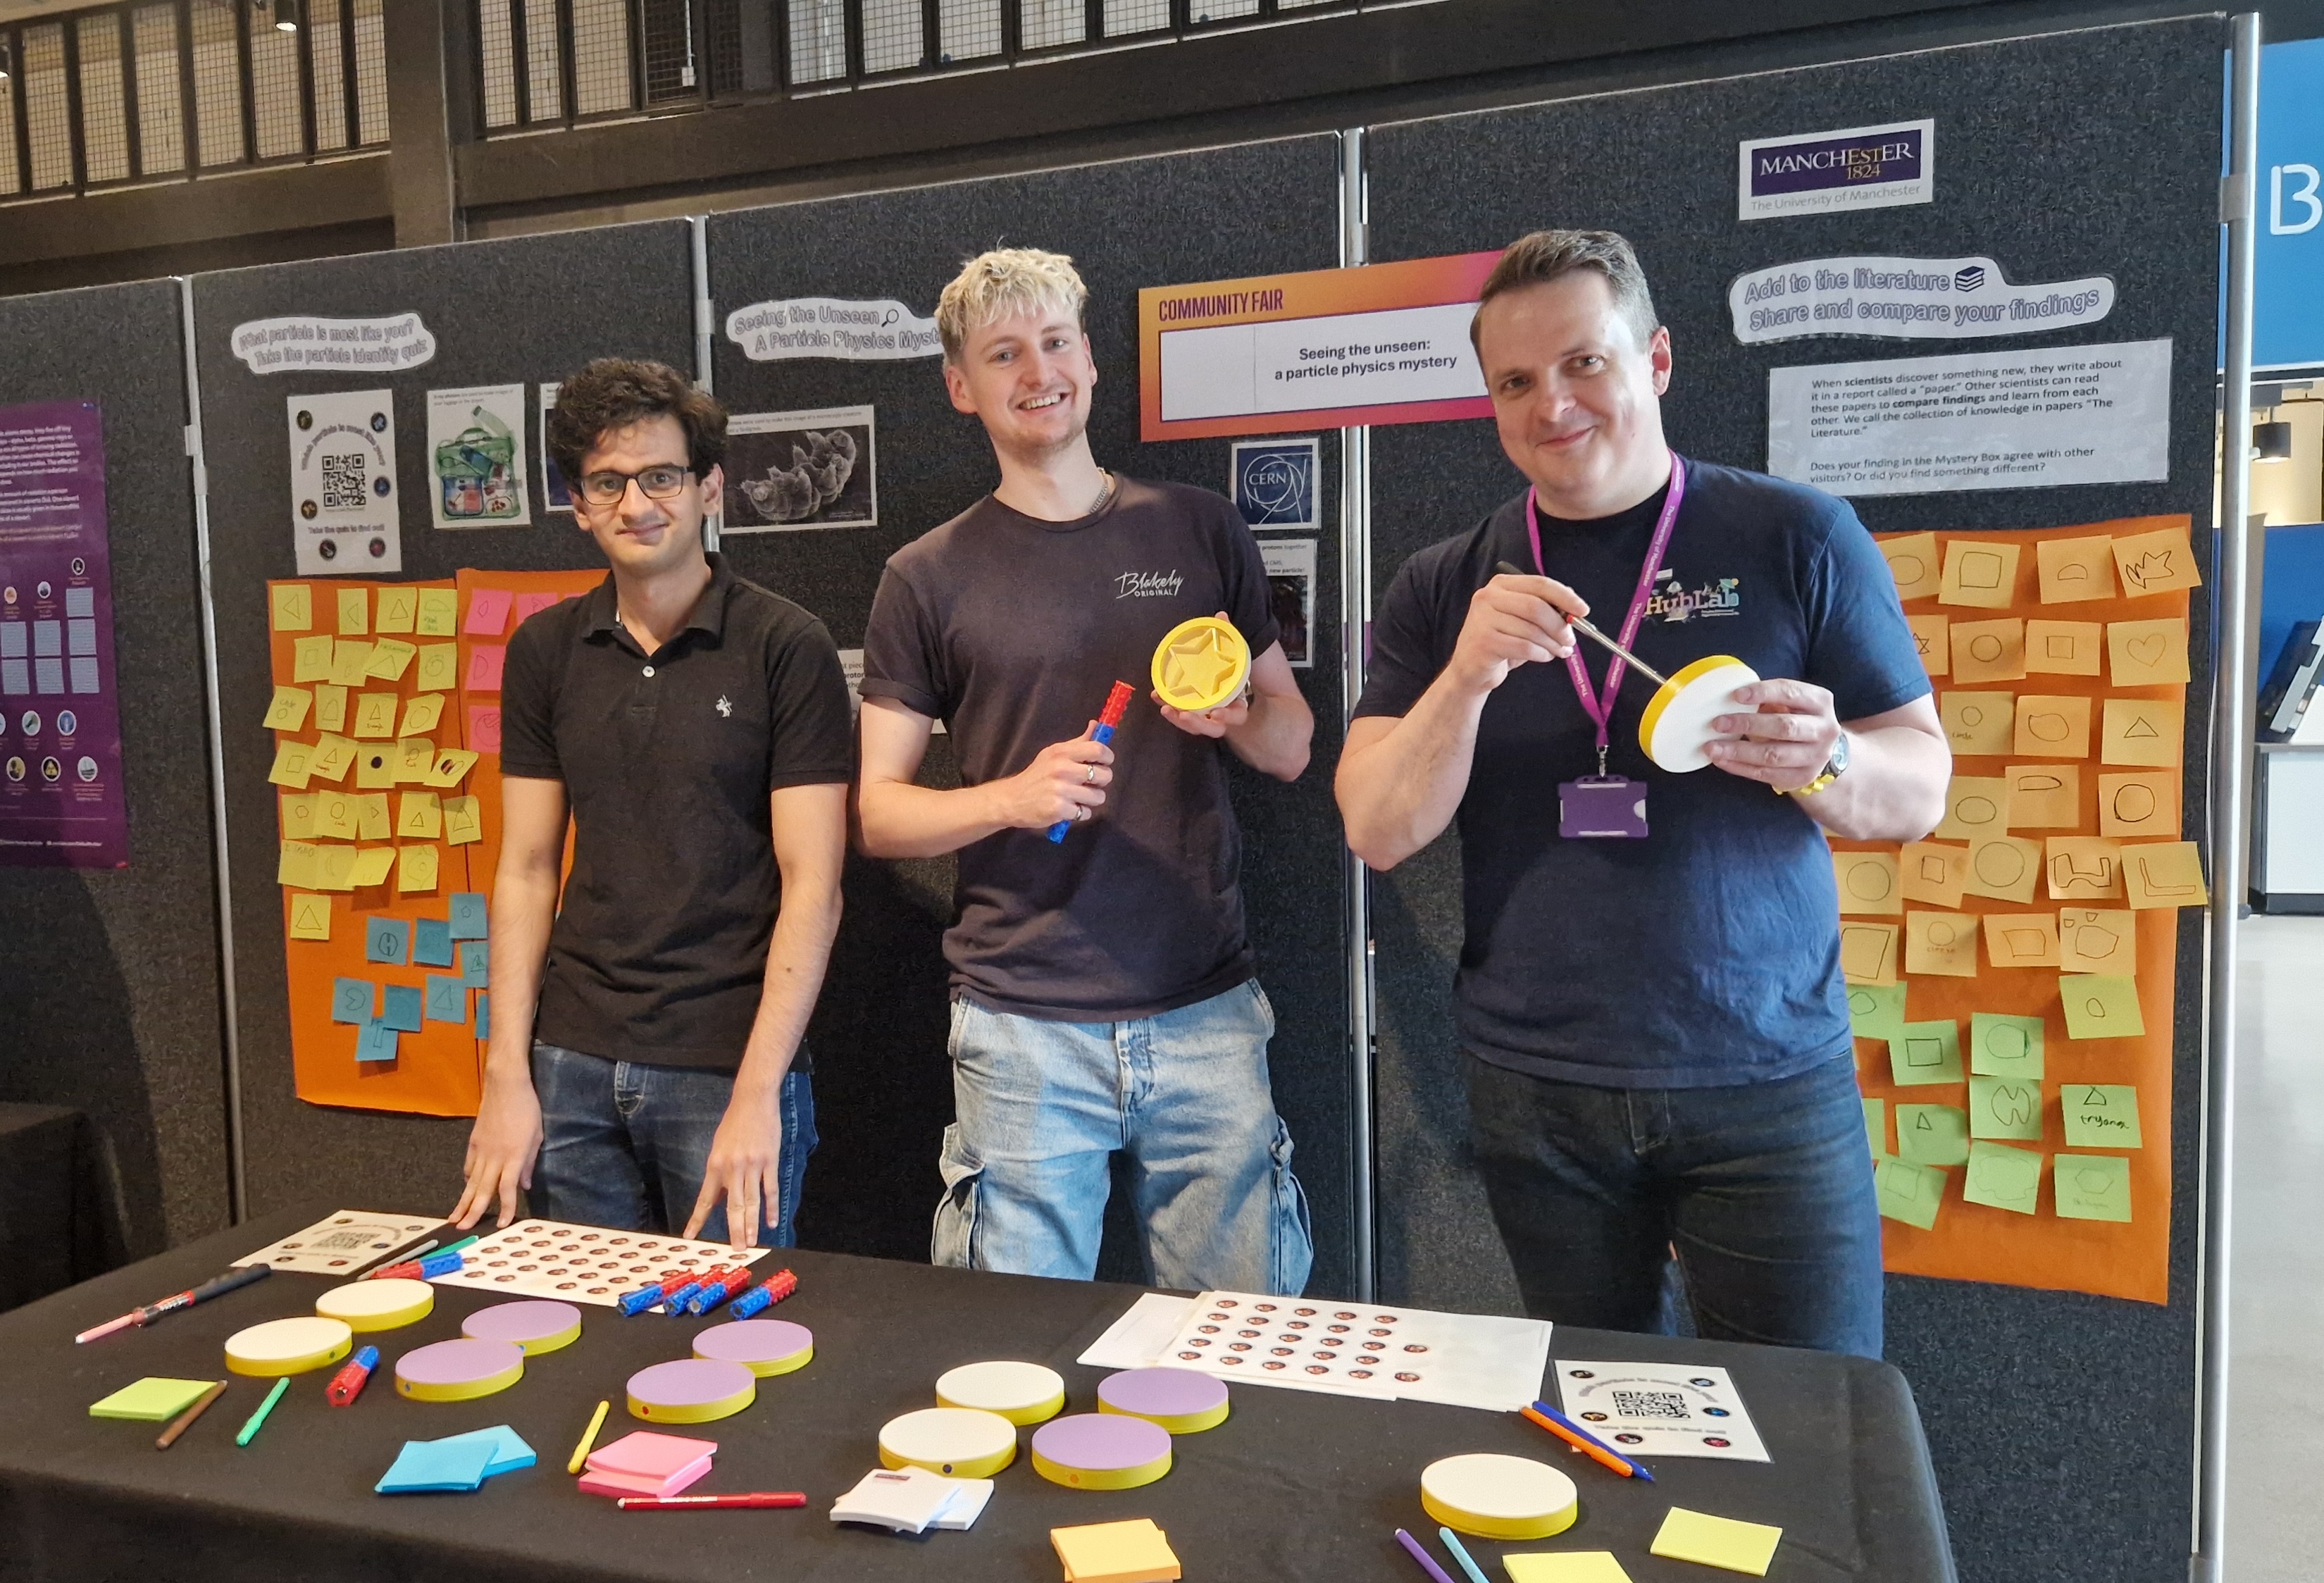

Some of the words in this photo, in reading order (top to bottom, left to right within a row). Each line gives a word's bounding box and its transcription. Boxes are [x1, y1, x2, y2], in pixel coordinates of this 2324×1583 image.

[1760, 142, 1915, 176] MANCHESTER
[1846, 163, 1881, 180] 1824
[1751, 201, 1772, 211] The
[1775, 194, 1832, 209] University
[1834, 192, 1848, 203] of
[1849, 185, 1920, 200] Manchester
[2270, 163, 2323, 236] B
[1744, 275, 1785, 304] Add
[1789, 273, 1810, 292] to
[1815, 269, 1848, 290] the
[1853, 268, 1951, 291] literature
[1159, 292, 1248, 321] COMMUNITY
[1252, 289, 1283, 312] FAIR
[1750, 304, 1809, 331] Share
[1814, 299, 1853, 319] and
[1857, 302, 1951, 325] compare
[1954, 304, 2006, 326] your
[2009, 290, 2099, 321] findings
[735, 309, 787, 335] Seeing
[790, 306, 815, 323] the
[819, 306, 881, 325] Unseen
[239, 329, 268, 352] What
[269, 325, 314, 344] particle
[317, 325, 327, 341] is
[329, 328, 359, 342] most
[361, 325, 382, 341] like
[385, 318, 414, 343] you?
[755, 336, 766, 353] A
[770, 331, 830, 349] Particle
[833, 331, 895, 352] Physics
[899, 327, 940, 351] Myst
[254, 351, 282, 367] Take
[284, 349, 301, 362] the
[306, 348, 351, 365] particle
[353, 347, 399, 364] identity
[402, 339, 428, 361] quiz
[1299, 346, 1346, 361] Seeing
[1349, 344, 1371, 356] the
[1374, 340, 1431, 354] unseen:
[1275, 371, 1283, 380] a
[1286, 364, 1338, 382] particle
[1342, 360, 1396, 378] physics
[1399, 356, 1458, 372] mystery
[1812, 379, 1842, 388] When
[1844, 375, 1893, 386] scientists
[1896, 373, 1939, 383] discover
[1942, 368, 1999, 380] something
[2001, 366, 2026, 375] new,
[2030, 364, 2054, 374] they
[2057, 361, 2086, 371] write
[2089, 359, 2122, 370] about
[1811, 392, 1818, 401] it
[1821, 392, 1831, 400] in
[1842, 389, 1874, 400] report
[1877, 386, 1908, 397] called
[1965, 381, 1996, 391] Other
[1999, 378, 2049, 389] scientists
[2052, 377, 2071, 385] can
[2075, 373, 2099, 384] read
[1811, 404, 1839, 414] these
[1842, 402, 1877, 413] papers
[1893, 397, 1939, 409] compare
[1943, 392, 1986, 404] findings
[1989, 392, 2008, 402] and
[2012, 390, 2039, 400] learn
[2043, 388, 2069, 398] from
[2073, 386, 2099, 396] each
[1844, 414, 1860, 424] We
[1863, 412, 1880, 423] call
[1883, 412, 1901, 421] the
[1903, 409, 1953, 420] collection
[1956, 407, 1968, 416] of
[1970, 404, 2029, 416] knowledge
[2032, 402, 2042, 411] in
[2045, 401, 2082, 412] papers
[1810, 461, 1835, 471] Does
[1838, 460, 1861, 471] your
[1864, 458, 1900, 468] finding
[1902, 457, 1912, 466] in
[1915, 456, 1932, 465] the
[1935, 454, 1978, 465] Mystery
[1982, 453, 2000, 462] Box
[2003, 451, 2034, 463] agree
[2037, 448, 2061, 459] with
[2064, 447, 2095, 457] other
[1810, 472, 1851, 483] visitors?
[1854, 472, 1867, 481] Or
[1870, 471, 1886, 480] did
[1888, 471, 1908, 481] you
[1910, 468, 1931, 478] find
[1934, 465, 1990, 477] something
[1993, 461, 2046, 474] different?
[1249, 472, 1287, 486] CERN
[1665, 505, 1675, 517] The
[1114, 569, 1184, 599] Blakely
[1134, 589, 1174, 597] ORIGINAL
[1646, 588, 1739, 615] HubLab
